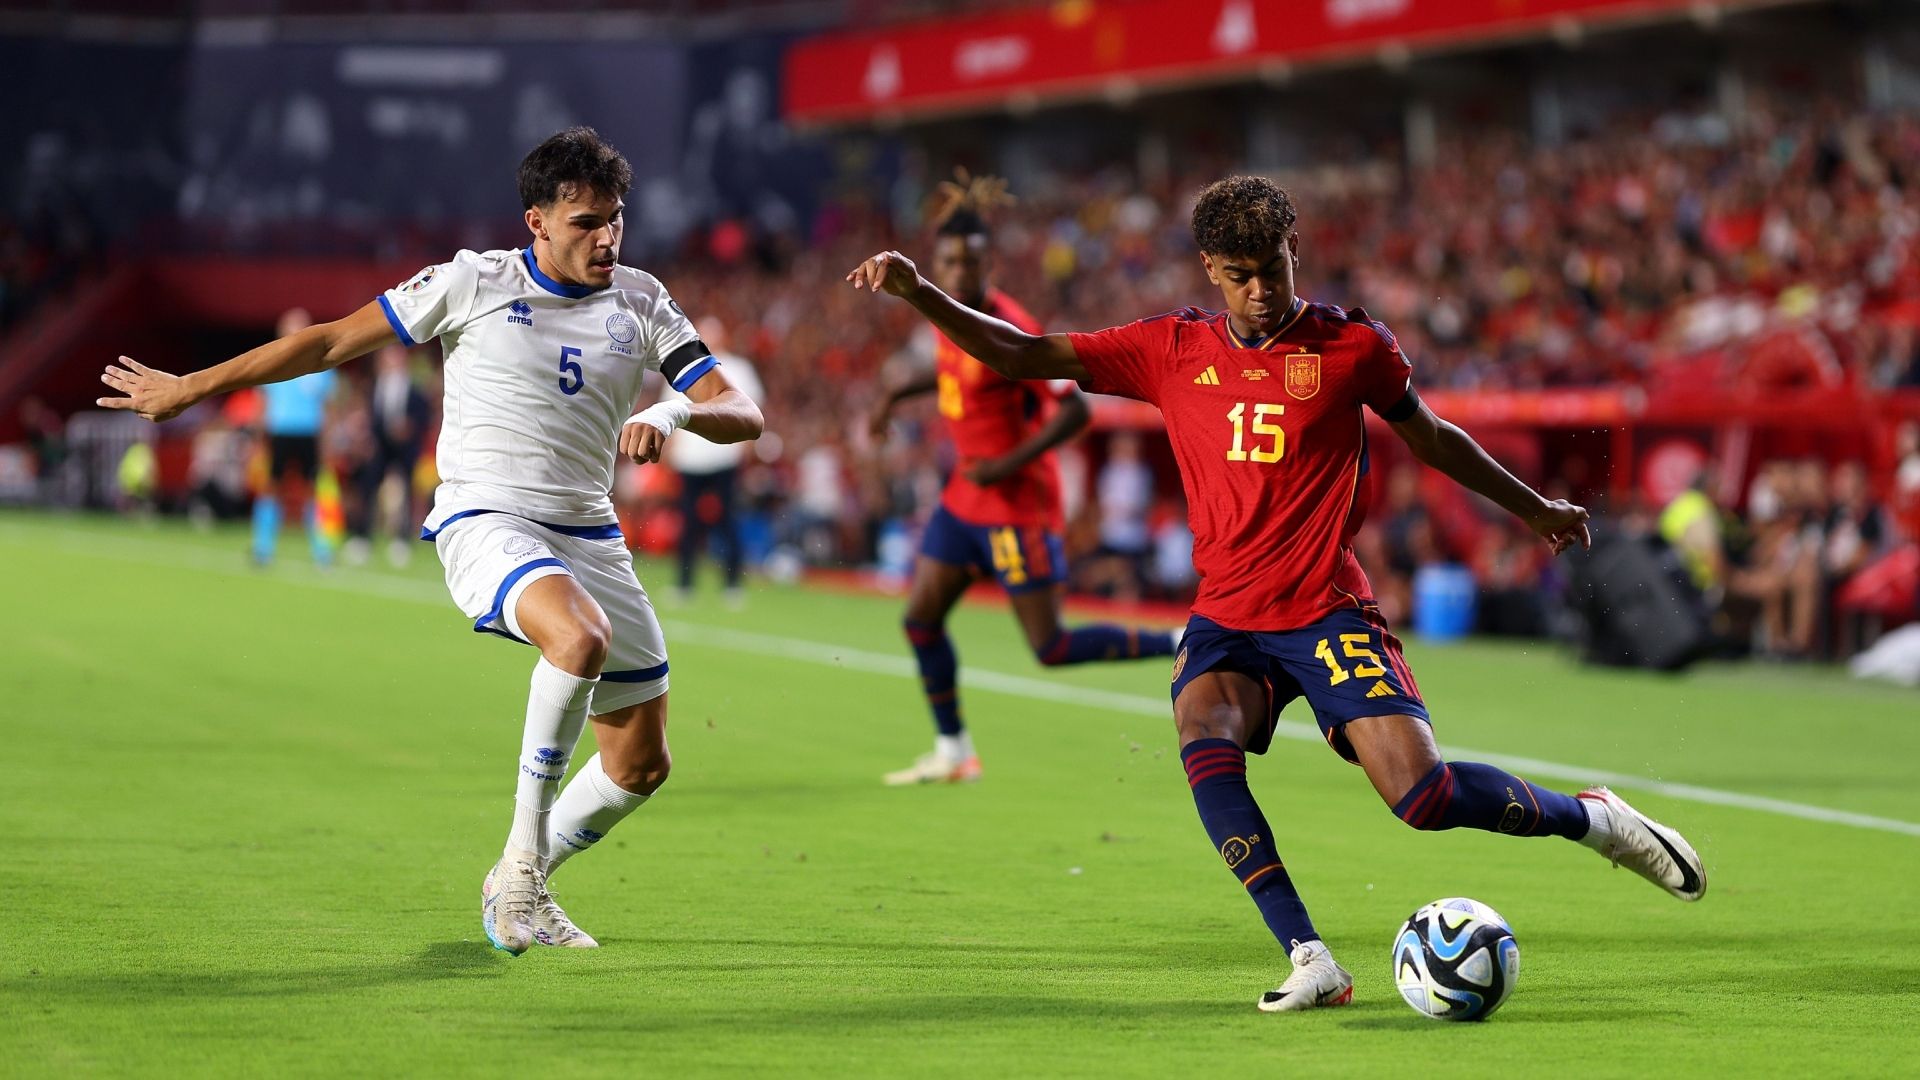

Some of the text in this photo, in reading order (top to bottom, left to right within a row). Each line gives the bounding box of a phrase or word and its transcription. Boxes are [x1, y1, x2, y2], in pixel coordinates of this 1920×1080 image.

[558, 345, 585, 396] 5
[609, 345, 632, 355] CYPRUS
[1226, 402, 1285, 464] 15
[1314, 633, 1388, 687] 15
